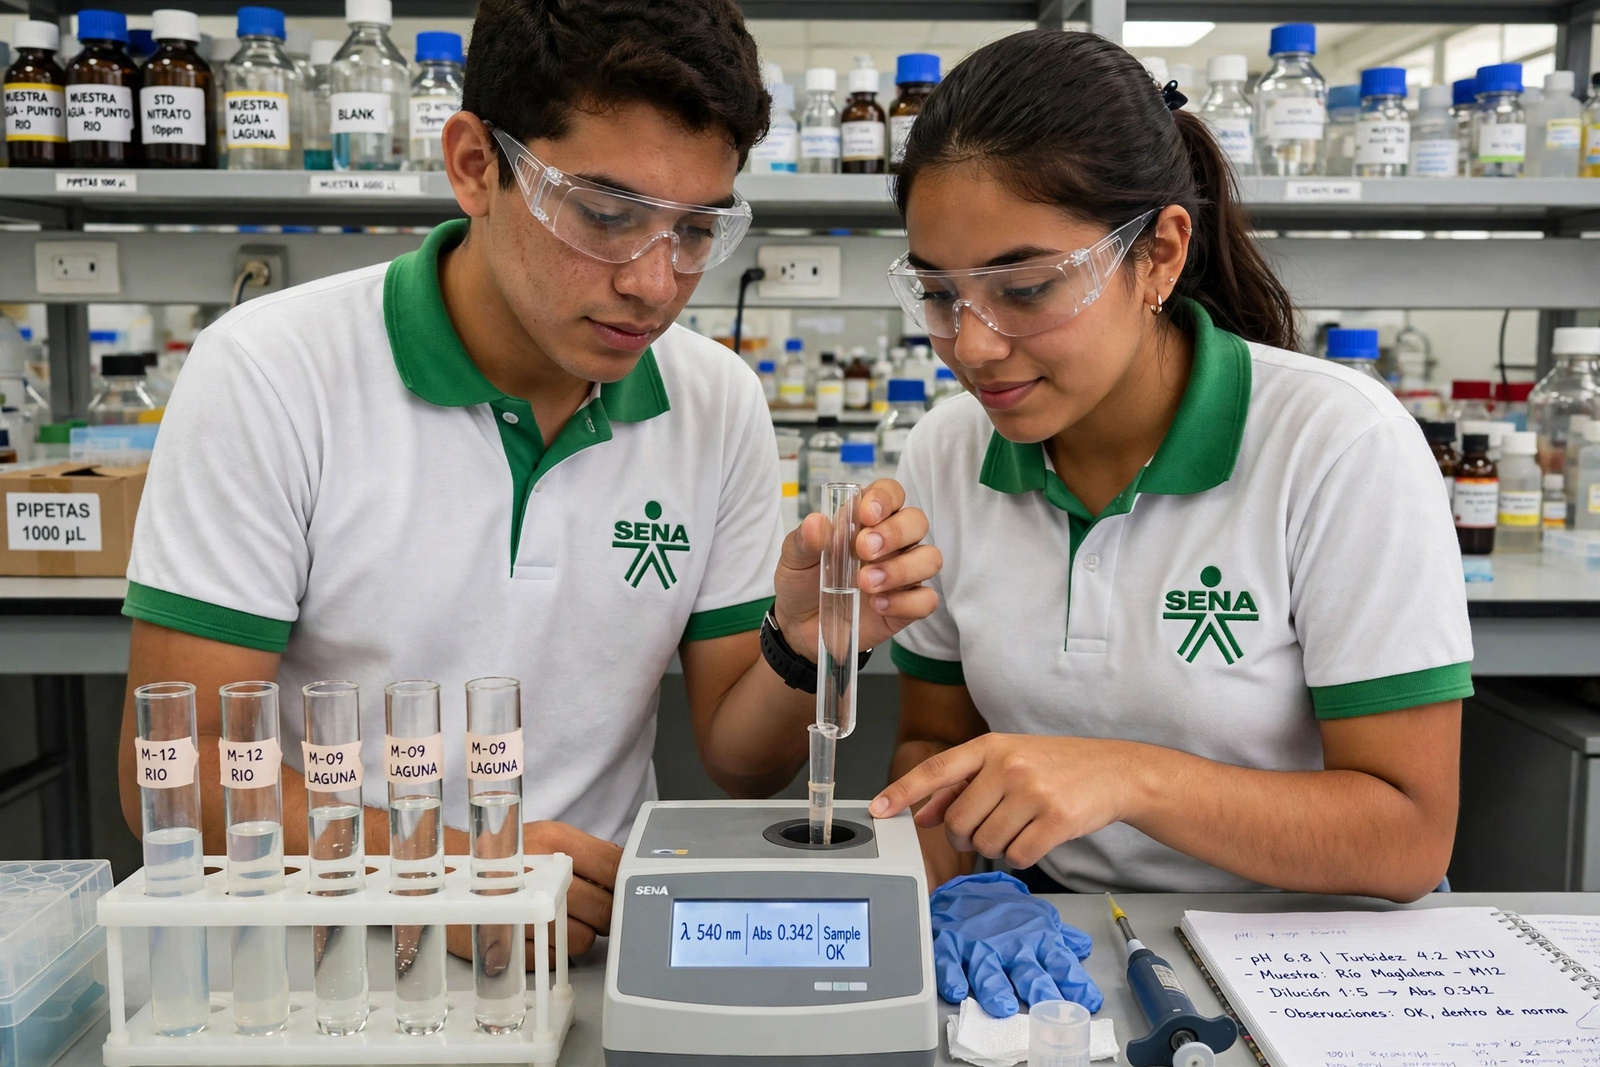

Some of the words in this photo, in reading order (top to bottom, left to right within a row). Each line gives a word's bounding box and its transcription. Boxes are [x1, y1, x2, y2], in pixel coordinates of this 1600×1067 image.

[6, 91, 48, 103] MUESTRA
[70, 92, 117, 104] MUESTRA
[154, 94, 175, 105] STD
[26, 105, 62, 118] PUNTO
[229, 99, 278, 111] MUESTRA
[68, 107, 86, 118] AGUA
[95, 106, 131, 119] PUNTO
[147, 108, 191, 120] NITRATO
[338, 109, 375, 121] BLANK
[15, 119, 31, 130] RIO
[233, 114, 260, 125] AGUA
[84, 121, 101, 132] RIO
[151, 125, 183, 137] 10ppm
[233, 128, 276, 140] LAGUNA
[17, 502, 90, 518] PIPETAS
[23, 525, 60, 541] 1000
[66, 525, 86, 544] µL
[614, 520, 689, 543] SENA
[1165, 590, 1258, 612] SENA
[141, 747, 177, 761] M-12
[390, 745, 426, 758] M-09
[471, 741, 506, 755] M-09
[227, 748, 264, 762] M-12
[309, 751, 344, 765] M-09
[390, 762, 437, 778] LAGUNA
[470, 760, 518, 775] LAGUNA
[145, 768, 168, 781] RIO
[231, 769, 254, 782] RIO
[308, 769, 357, 785] LAGUNA
[635, 885, 669, 896] SENA
[696, 923, 722, 941] 540
[725, 928, 741, 941] nm
[752, 924, 772, 941] Abs
[777, 923, 813, 941] 0.342
[823, 926, 861, 944] Sample
[826, 944, 845, 960] OK
[1250, 952, 1273, 966] pH
[1284, 953, 1312, 963] 6.8
[1336, 952, 1407, 963] Turbidez
[1417, 951, 1448, 961] 4.2
[1455, 949, 1495, 960] NTU
[1259, 969, 1327, 980] Muestra:
[1335, 968, 1361, 980] Río
[1468, 966, 1506, 976] M12
[1269, 987, 1330, 998] Dilución
[1338, 987, 1368, 998] 1:5
[1409, 986, 1436, 997] Abs
[1443, 985, 1494, 996] 0.342
[1284, 1008, 1394, 1019] Observaciones:
[1403, 1007, 1435, 1019] OK,
[1442, 1007, 1487, 1017] dentro
[1496, 1006, 1514, 1016] de
[1521, 1007, 1568, 1015] norma
